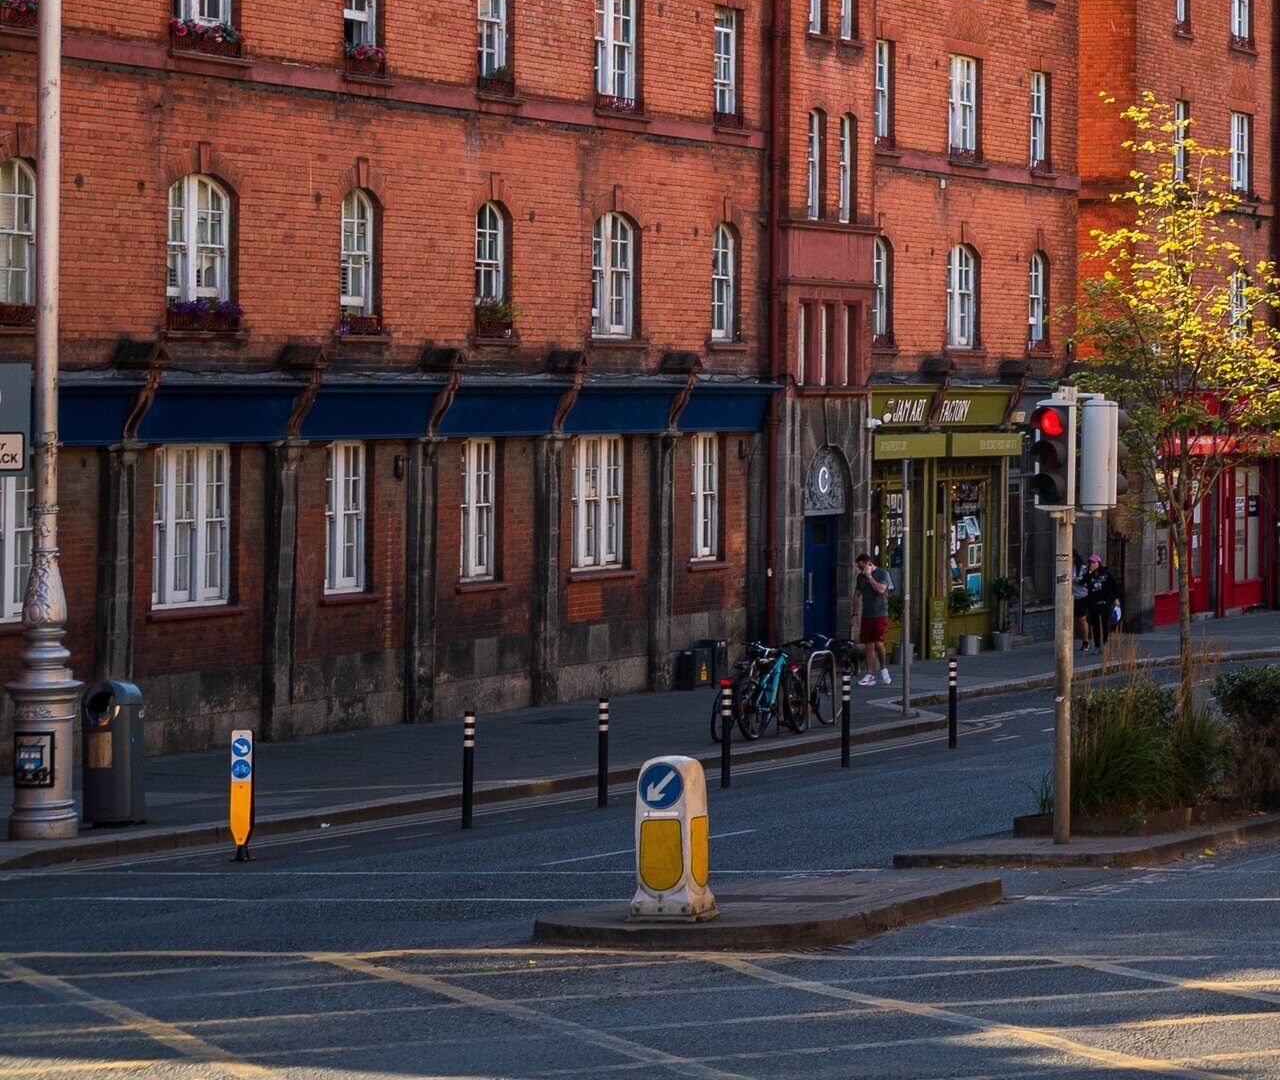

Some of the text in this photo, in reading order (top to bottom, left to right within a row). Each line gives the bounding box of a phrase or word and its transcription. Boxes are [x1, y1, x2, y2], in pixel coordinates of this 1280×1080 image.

[892, 398, 972, 423] JAM ART FACTORY
[818, 466, 829, 494] C
